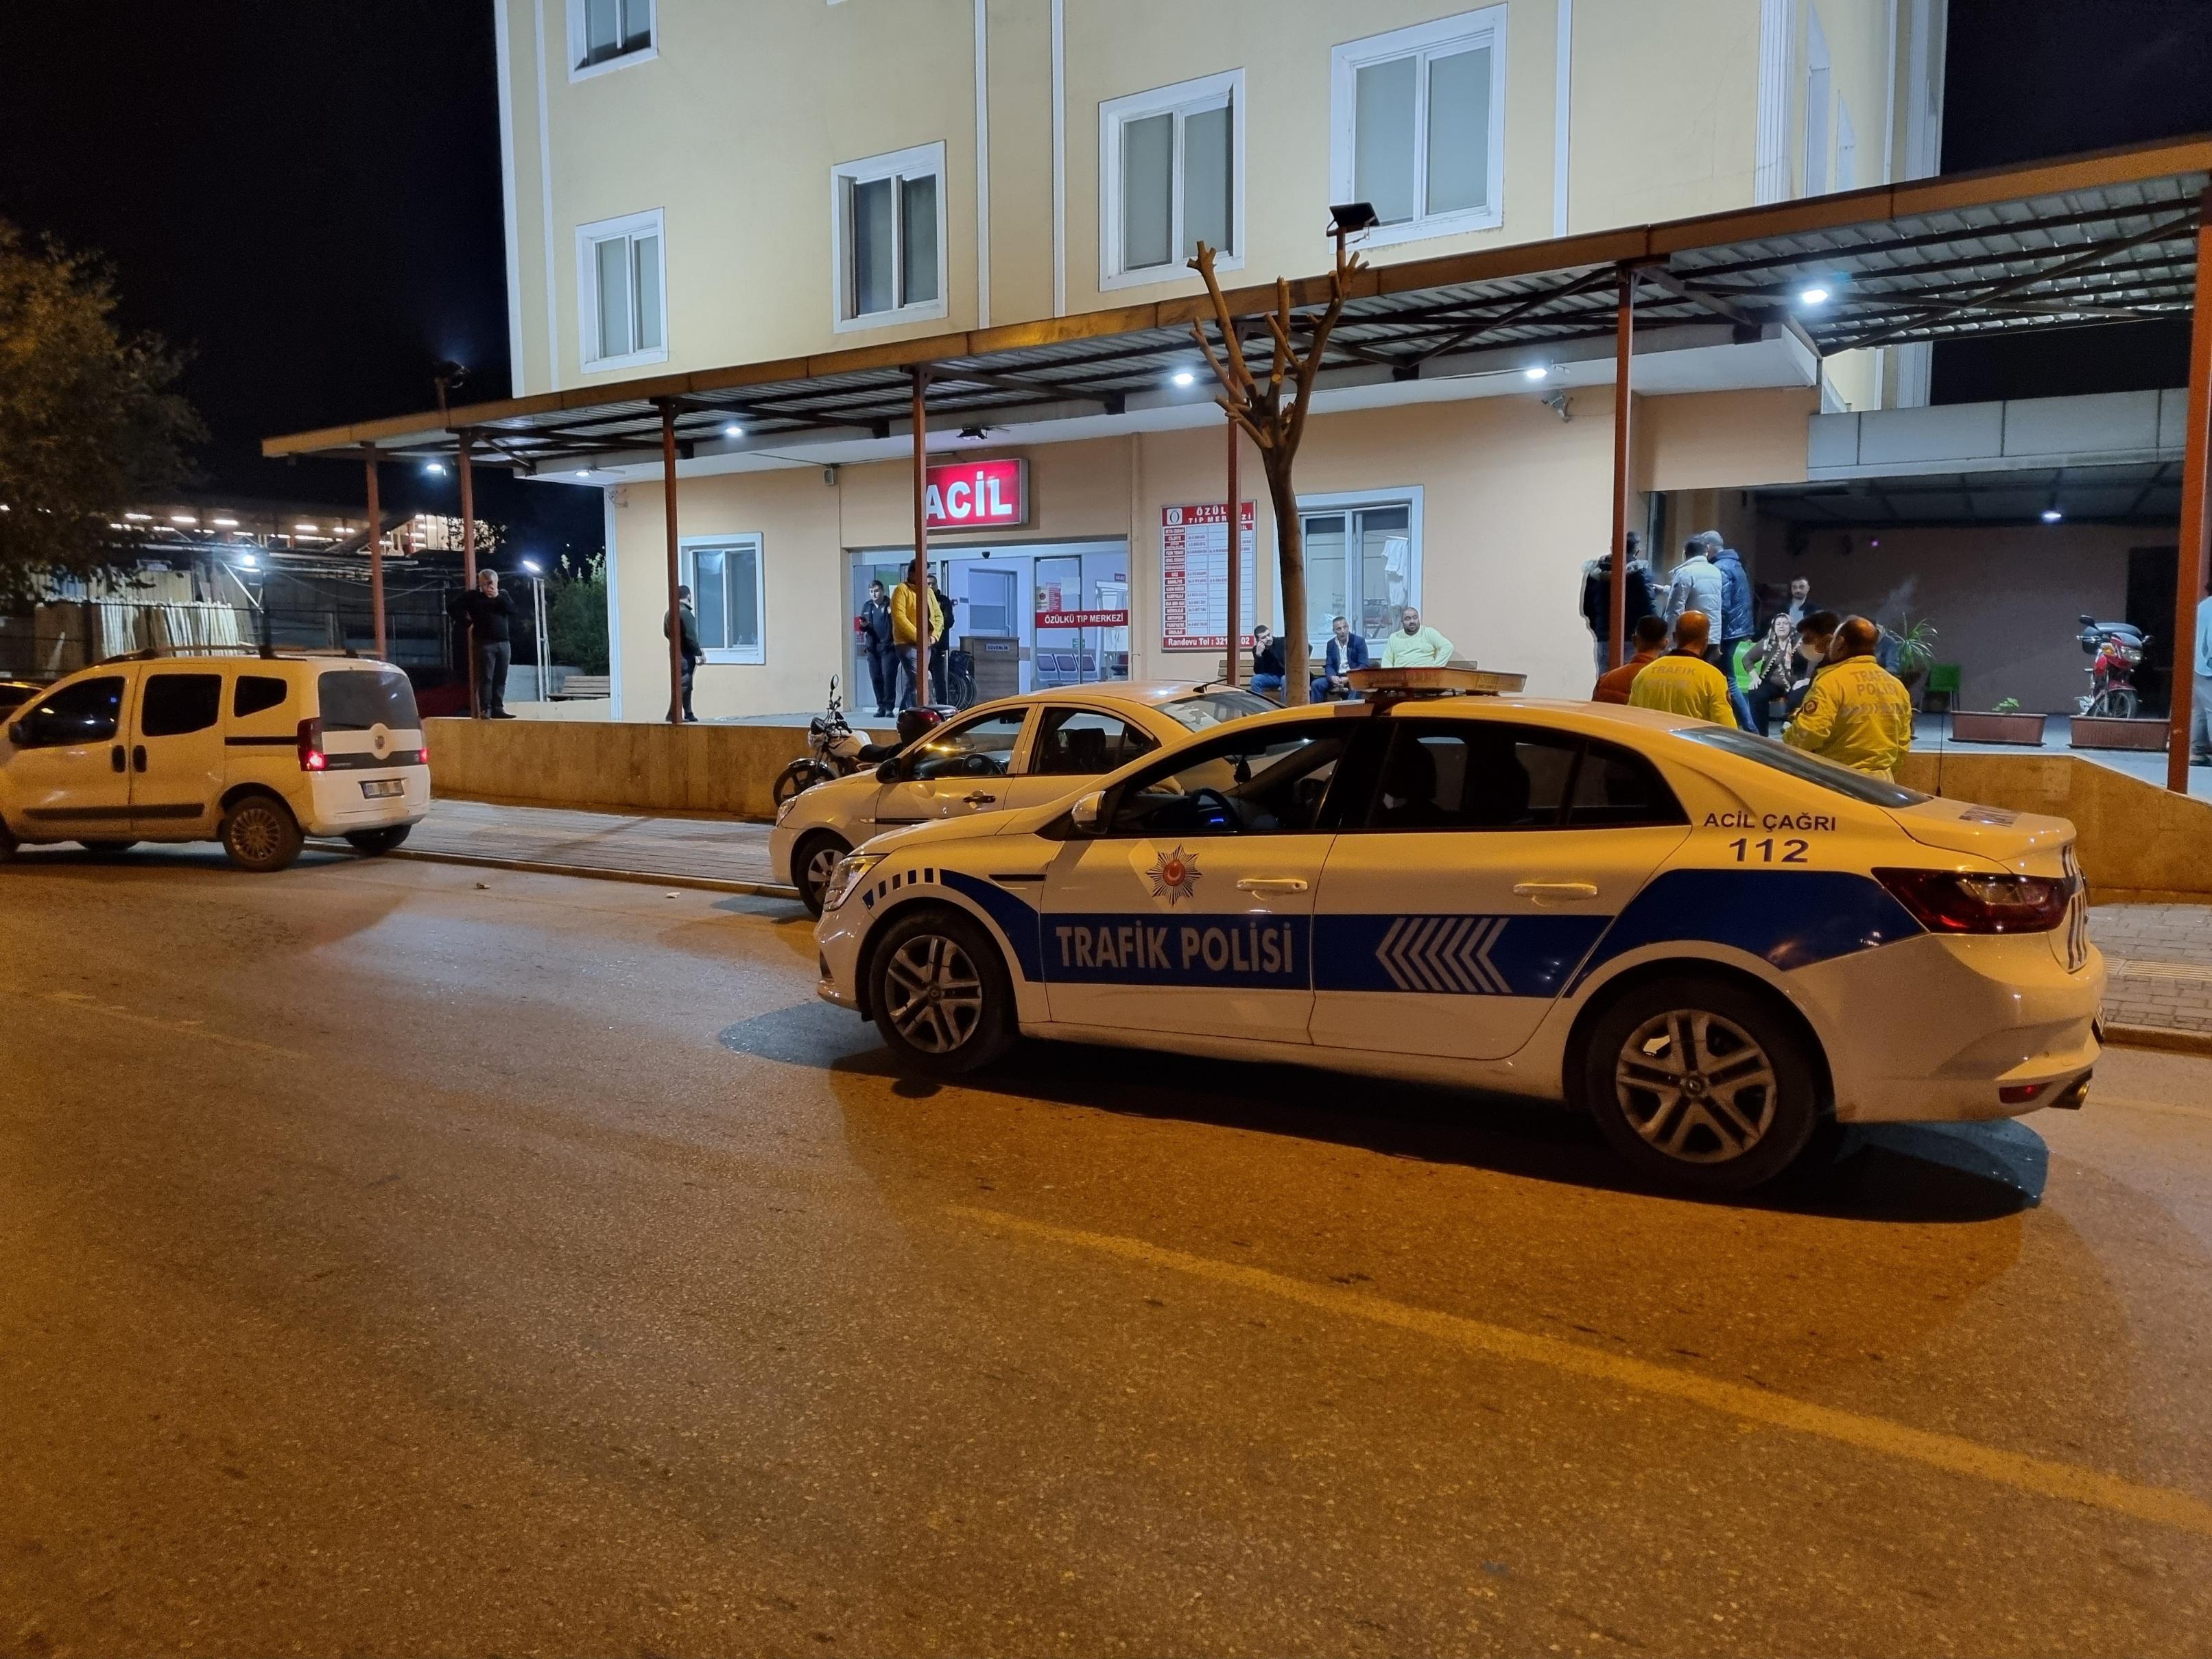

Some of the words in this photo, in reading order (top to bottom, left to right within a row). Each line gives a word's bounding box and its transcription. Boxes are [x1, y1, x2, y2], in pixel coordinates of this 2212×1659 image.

[926, 470, 1012, 520] ACİL
[1045, 613, 1075, 624] ÖZÜLKÜ
[1089, 612, 1123, 623] MERKEZİ
[1168, 638, 1197, 646] Randevu
[1199, 637, 1209, 645] Tel
[1703, 811, 1755, 828] ACİL
[1763, 812, 1835, 833] ÇAĞRI
[1729, 837, 1809, 863] 112
[1056, 919, 1172, 970] TRAFİK
[1180, 921, 1293, 973] POLİSİ
